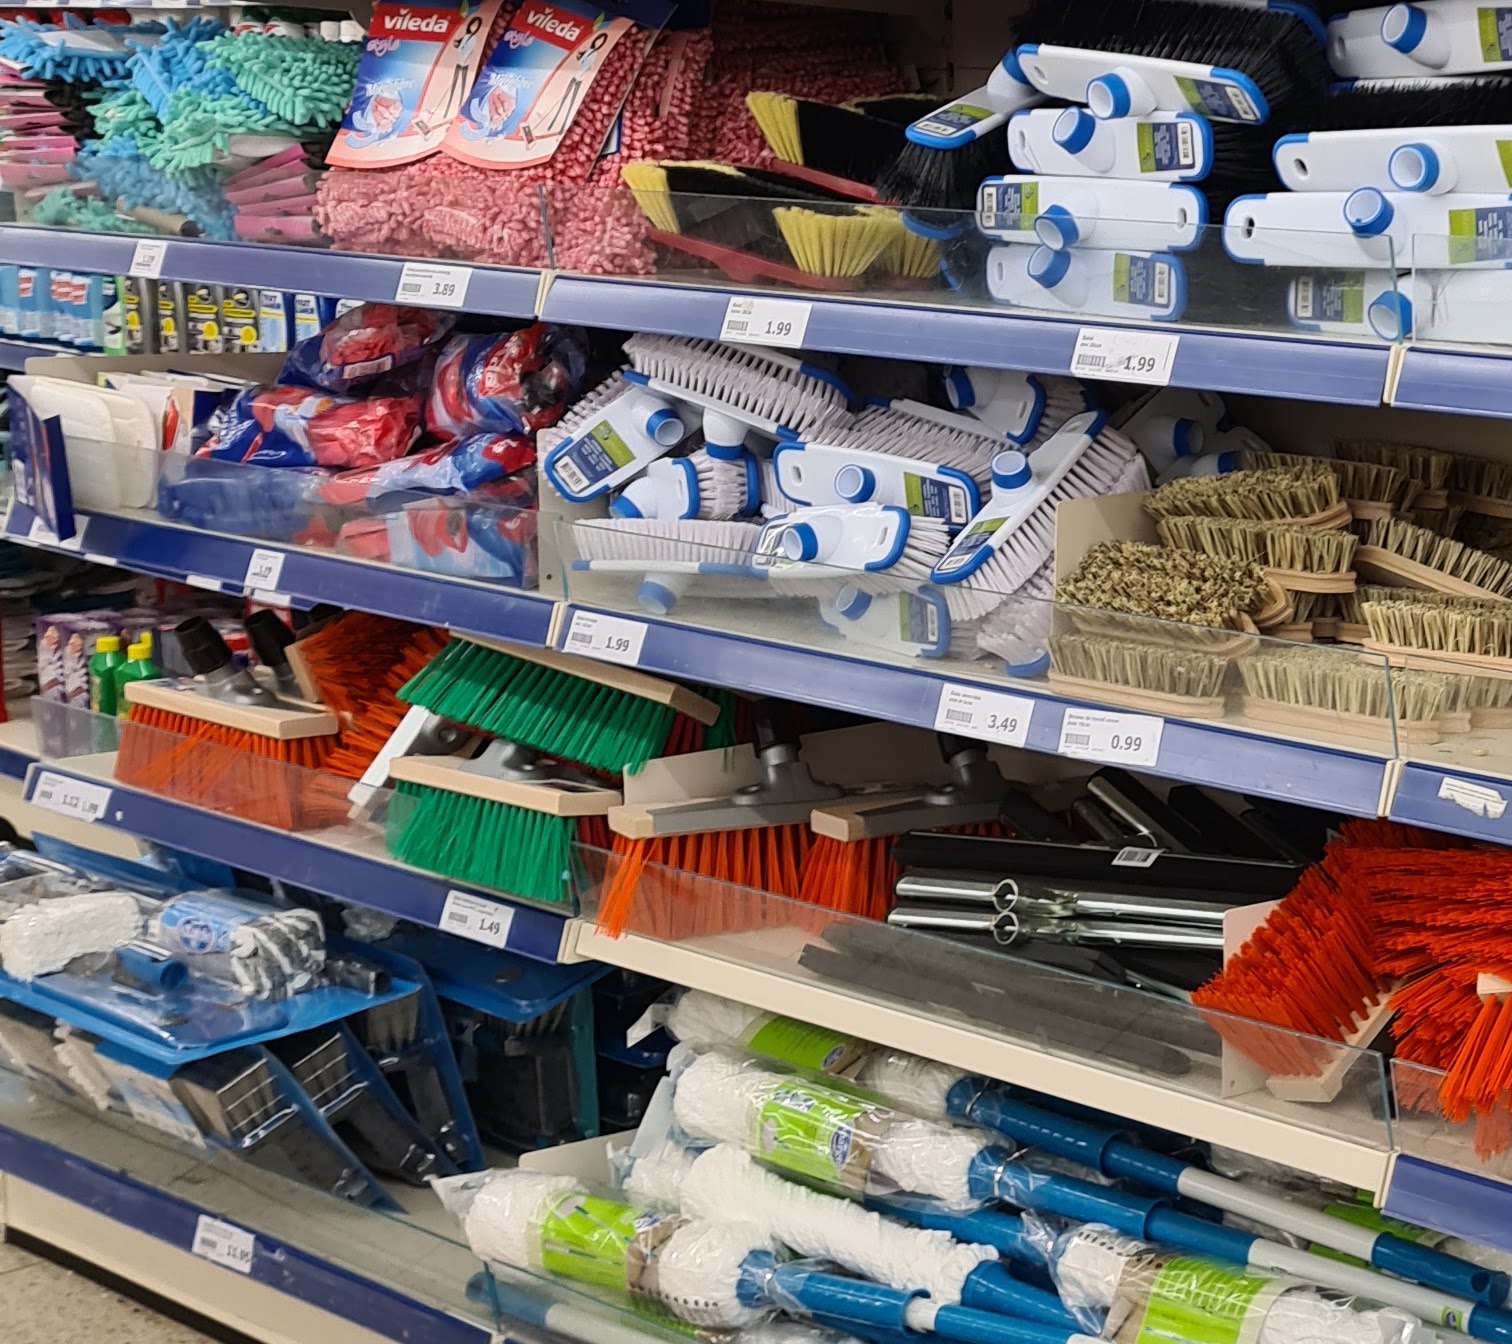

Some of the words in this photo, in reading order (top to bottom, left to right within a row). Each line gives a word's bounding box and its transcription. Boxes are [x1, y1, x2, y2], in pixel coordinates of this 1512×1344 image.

[383, 10, 451, 33] vileda
[526, 7, 583, 42] vileda
[432, 281, 456, 298] 3.89
[764, 320, 792, 337] 1.99
[1123, 354, 1156, 373] 1.99
[605, 635, 630, 652] 1.99
[986, 714, 1018, 734] 3.49
[1110, 734, 1142, 752] 0.99
[478, 918, 501, 936] 1.49
